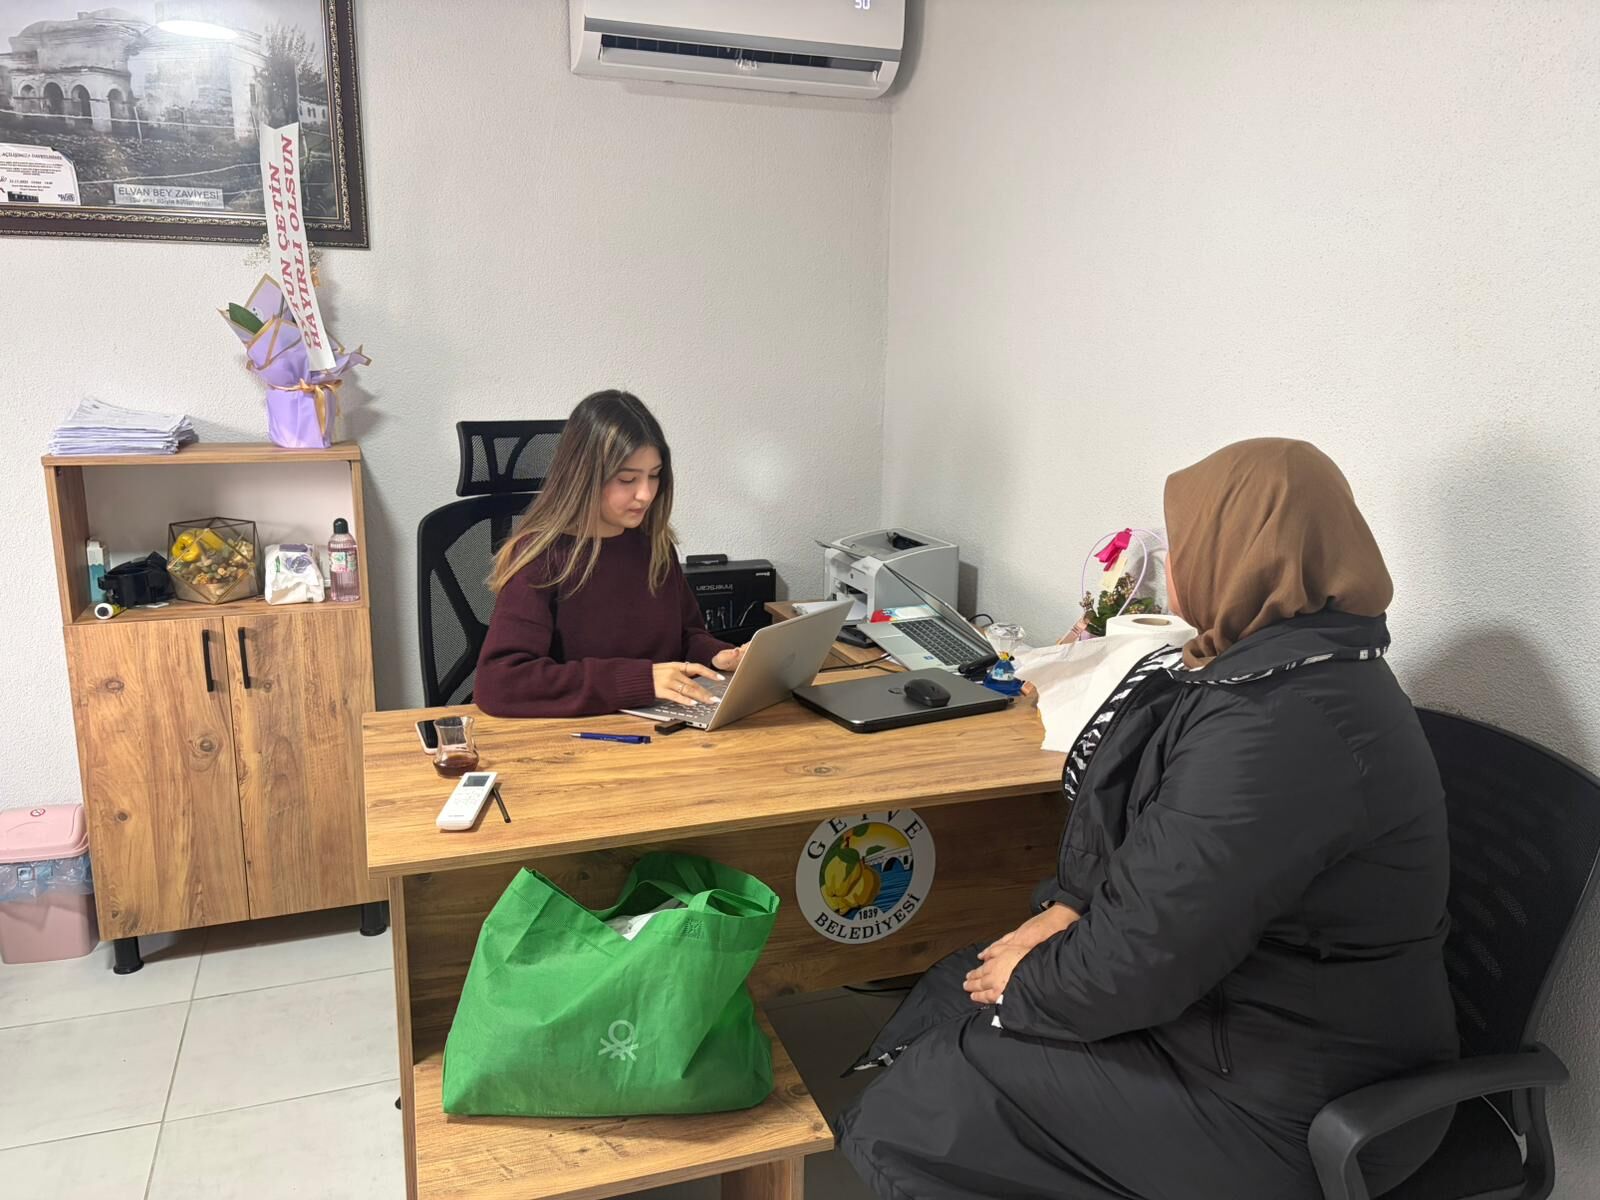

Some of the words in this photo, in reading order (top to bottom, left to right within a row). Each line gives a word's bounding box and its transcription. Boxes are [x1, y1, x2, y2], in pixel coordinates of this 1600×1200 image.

[118, 187, 150, 196] ELVAN
[153, 188, 172, 197] BEY
[269, 161, 290, 251] ÇETİN
[281, 134, 300, 232] OLSUN
[293, 239, 322, 350] HAYIRLI
[814, 893, 920, 939] BELEDİYESİ
[859, 908, 878, 920] 1839
